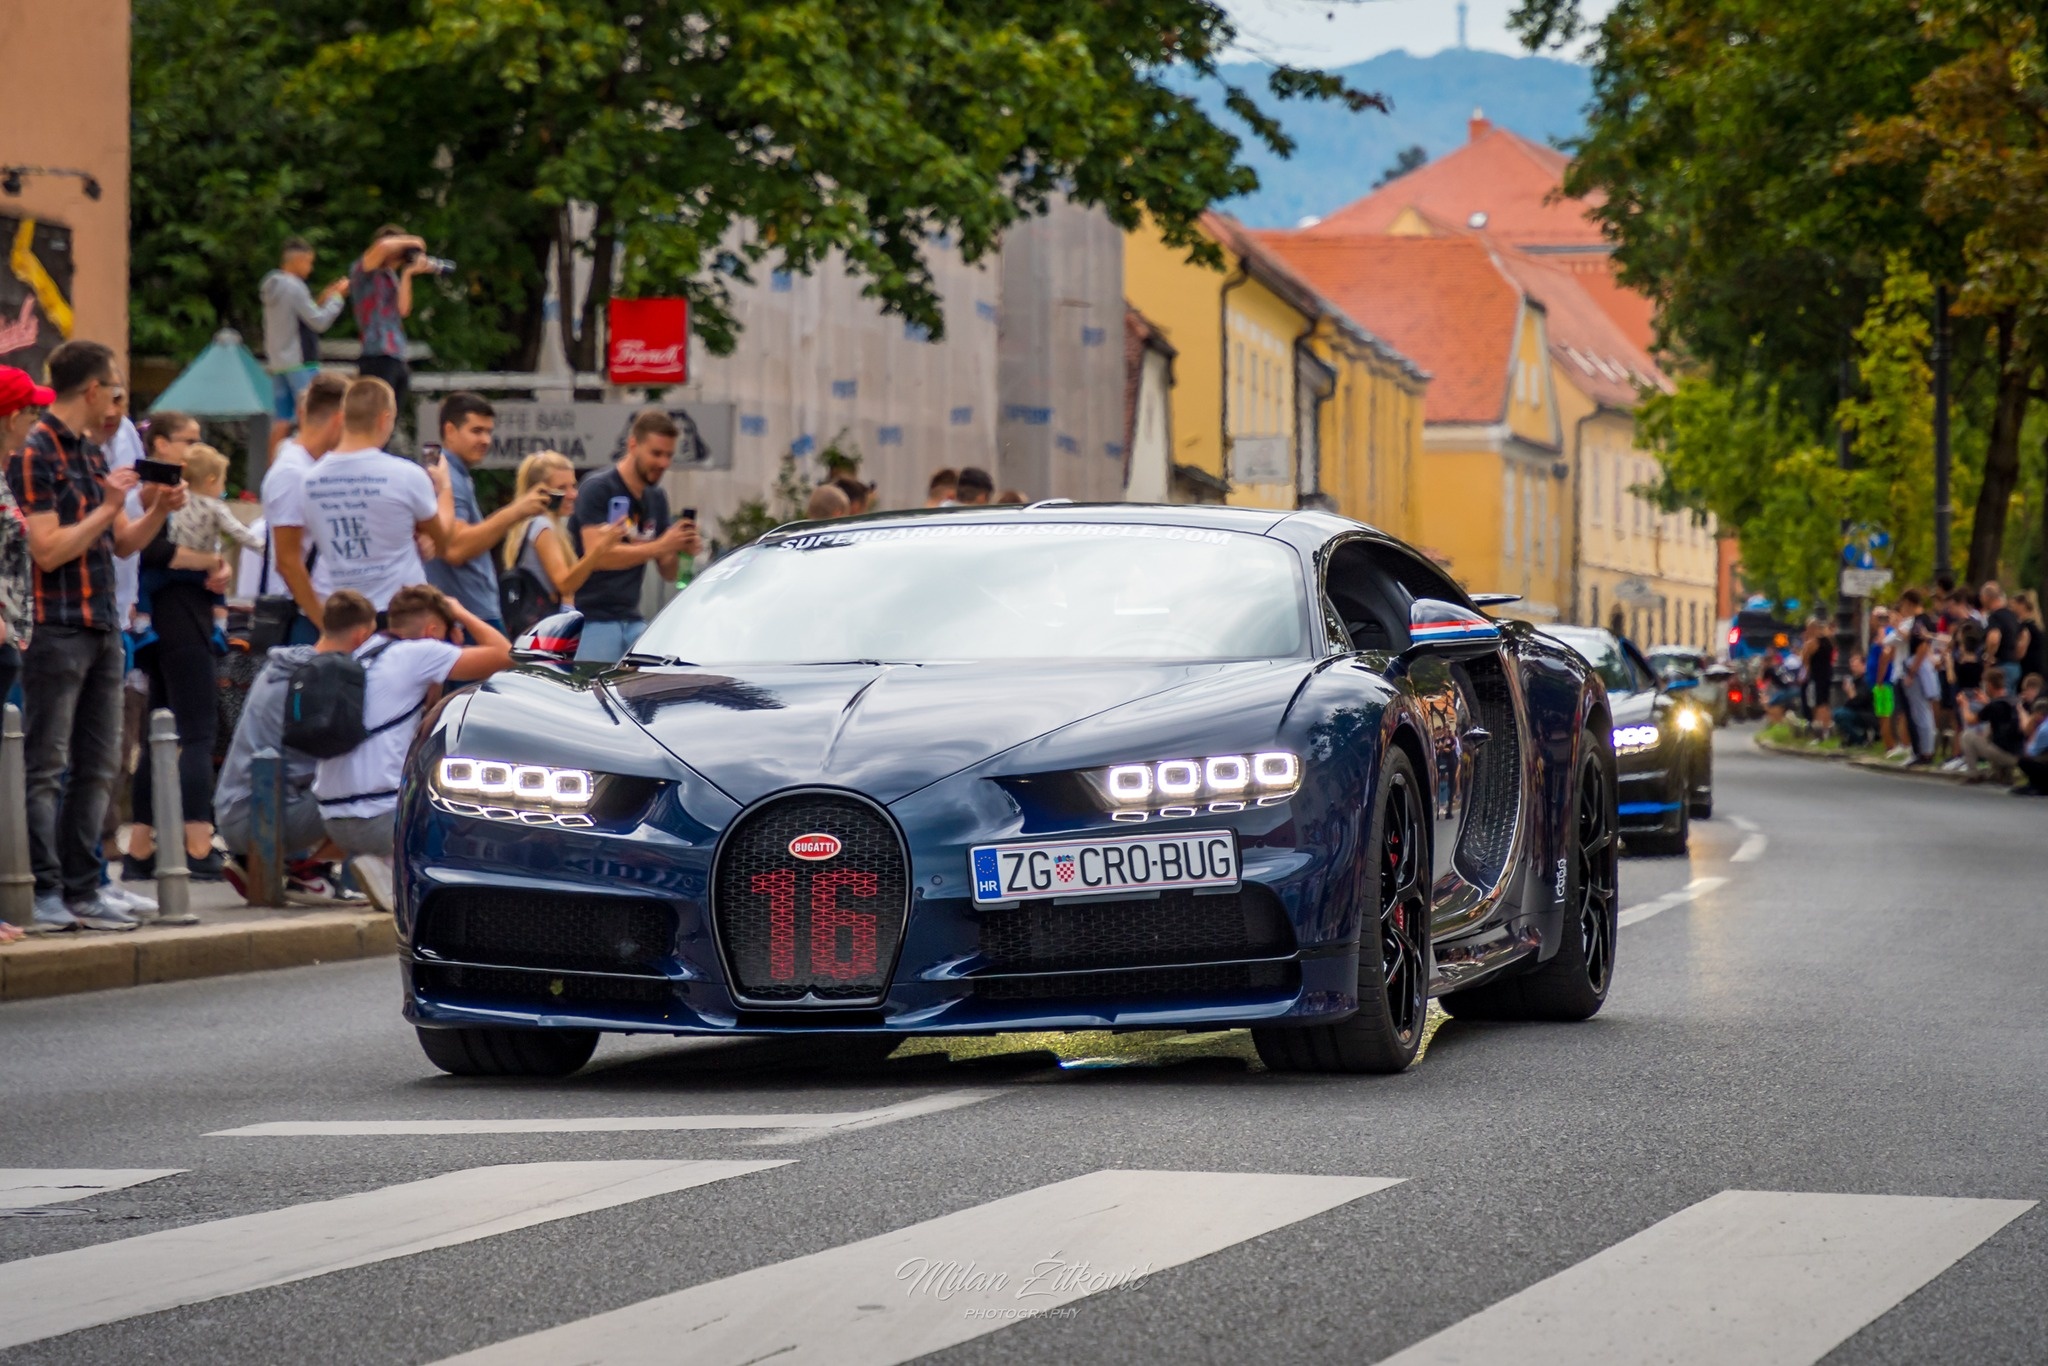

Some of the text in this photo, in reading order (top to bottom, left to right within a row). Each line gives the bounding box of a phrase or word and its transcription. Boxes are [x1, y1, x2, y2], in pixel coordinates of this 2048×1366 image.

[778, 523, 1232, 551] SUPERCAROWNERSCIRCLE.COM
[794, 842, 835, 853] BUGATTI
[1002, 851, 1051, 892] ZG
[979, 881, 998, 892] HR
[752, 868, 877, 979] 16
